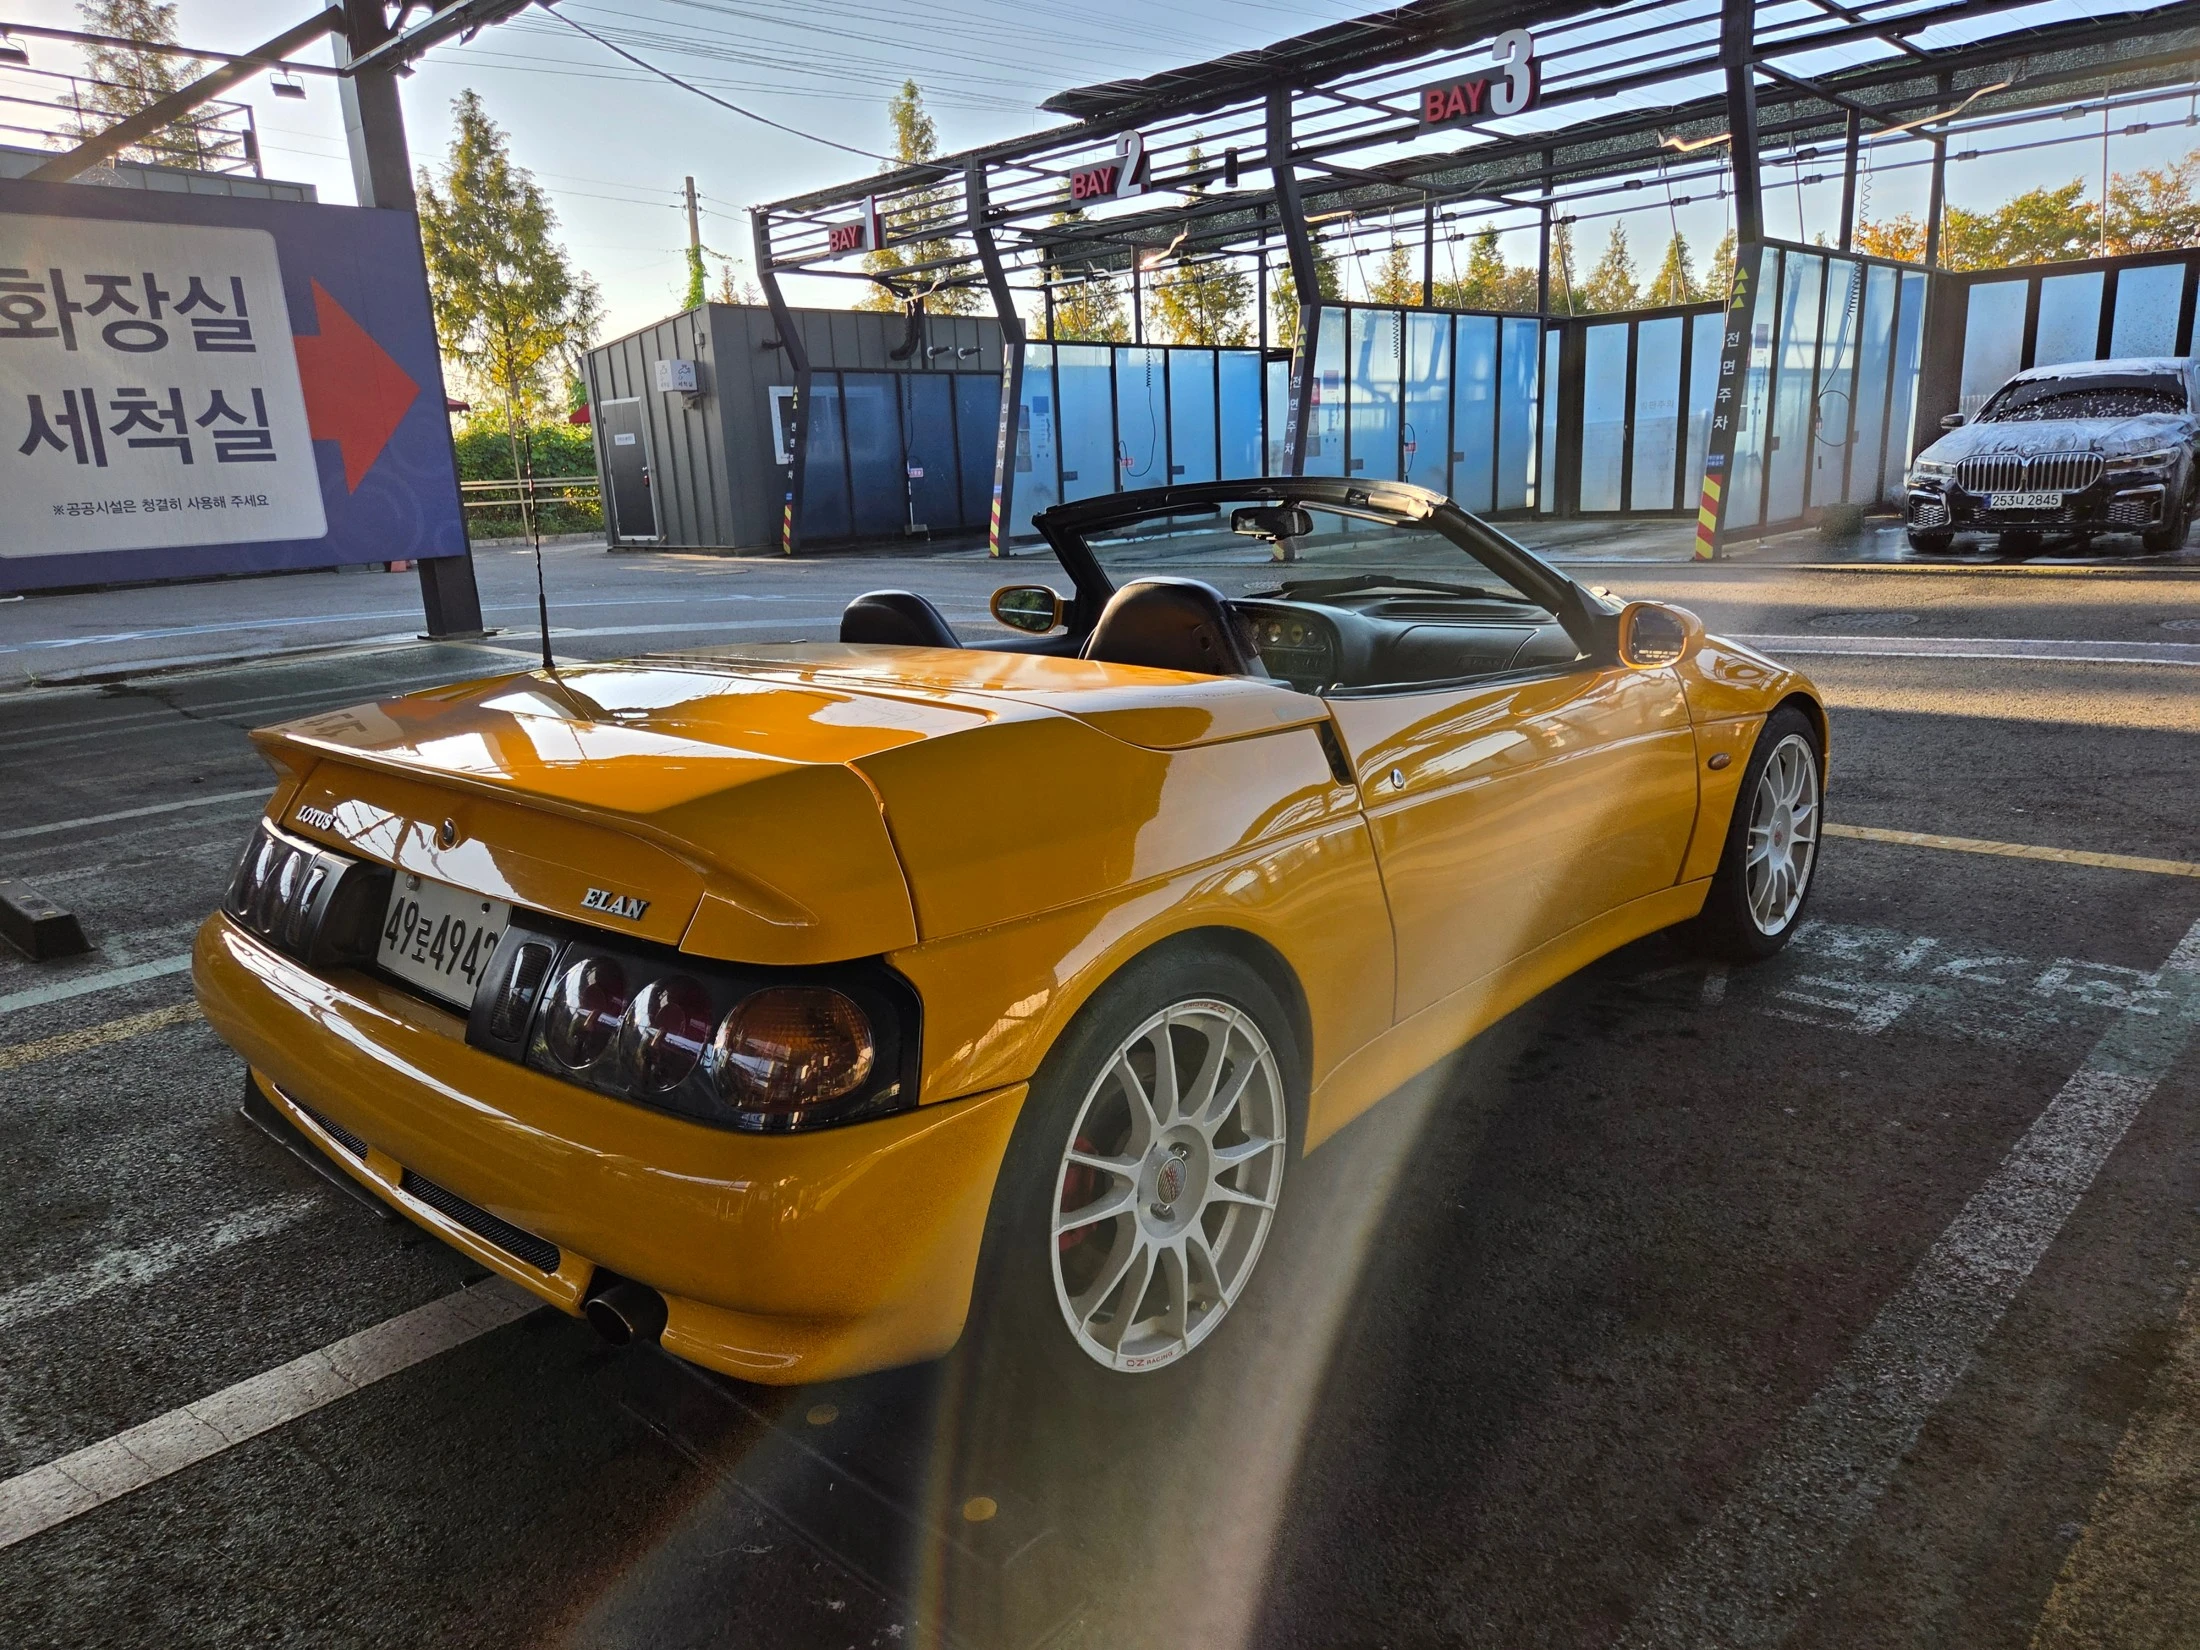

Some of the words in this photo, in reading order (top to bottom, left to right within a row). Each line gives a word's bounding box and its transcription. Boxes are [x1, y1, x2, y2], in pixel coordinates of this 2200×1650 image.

[1425, 79, 1487, 123] BAY
[1491, 28, 1533, 115] 3
[1073, 166, 1113, 199] BAY
[1116, 129, 1143, 198] 2
[830, 225, 859, 252] BAY
[859, 195, 879, 251] 1
[0, 269, 257, 353] 화장실
[1713, 331, 1740, 431] 전면주차
[18, 387, 278, 468] 세척실
[1284, 375, 1302, 455] 전면주차
[141, 498, 183, 513] 청결히
[187, 495, 227, 511] 사용해
[230, 494, 270, 508] 주세요
[2027, 494, 2059, 506] 2845
[295, 805, 334, 831] LOTUS
[580, 887, 650, 920] ELAN
[1126, 1359, 1145, 1367] OZ
